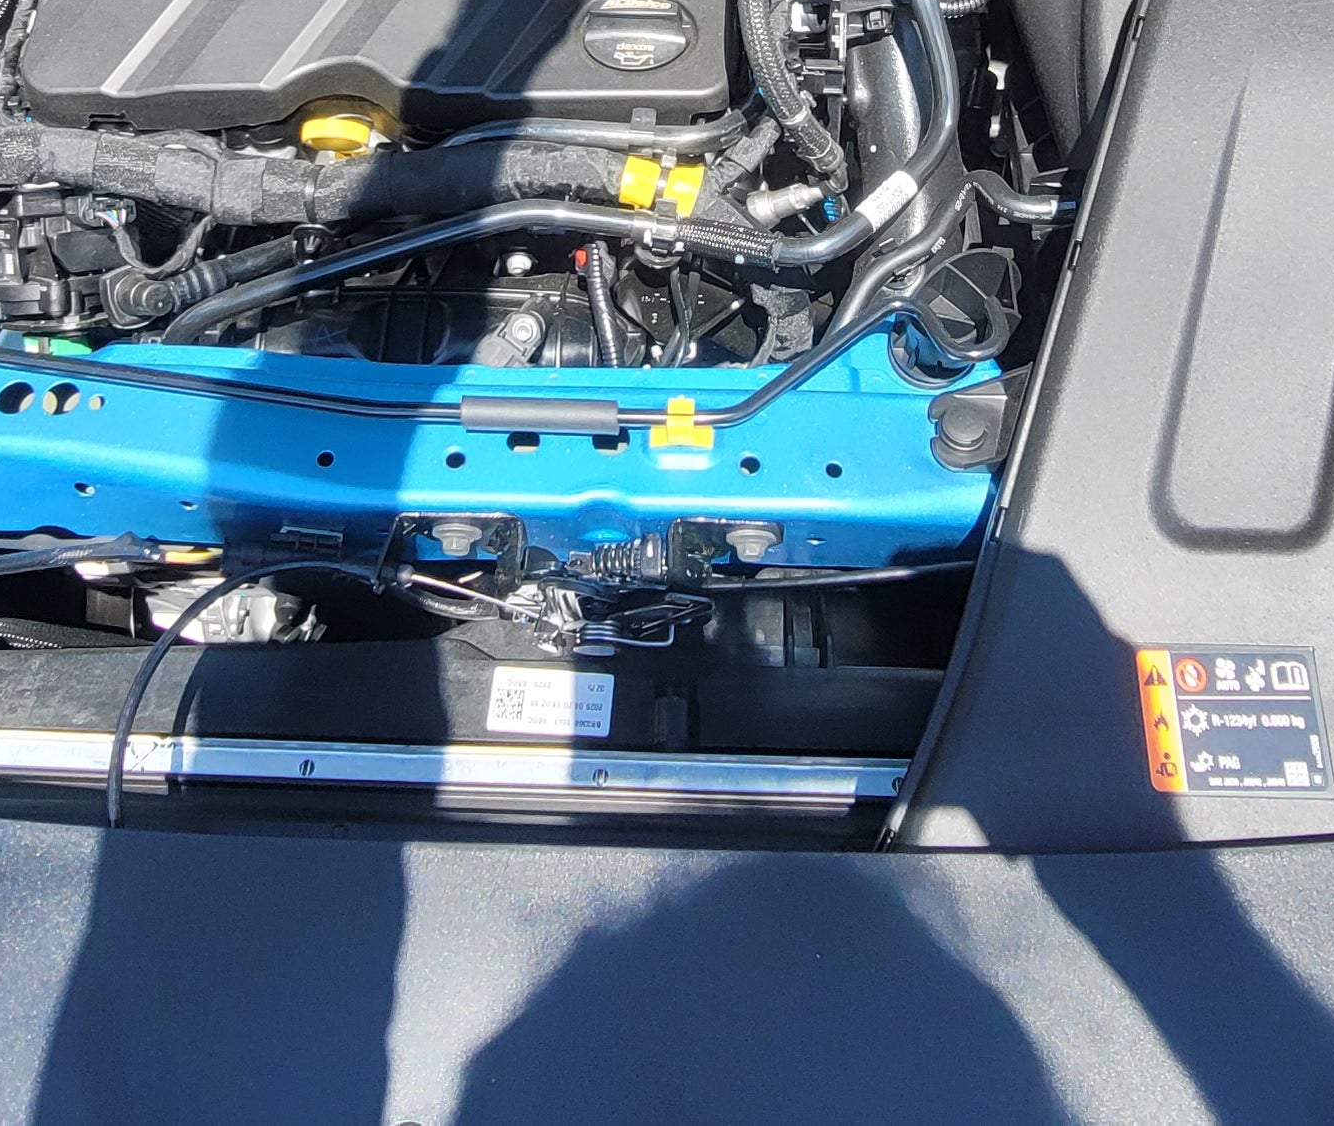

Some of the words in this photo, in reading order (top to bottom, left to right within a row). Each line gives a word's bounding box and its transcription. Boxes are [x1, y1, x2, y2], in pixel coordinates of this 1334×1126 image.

[1215, 679, 1241, 691] AUTO
[1291, 715, 1306, 729] kg
[1217, 755, 1241, 770] PAG
